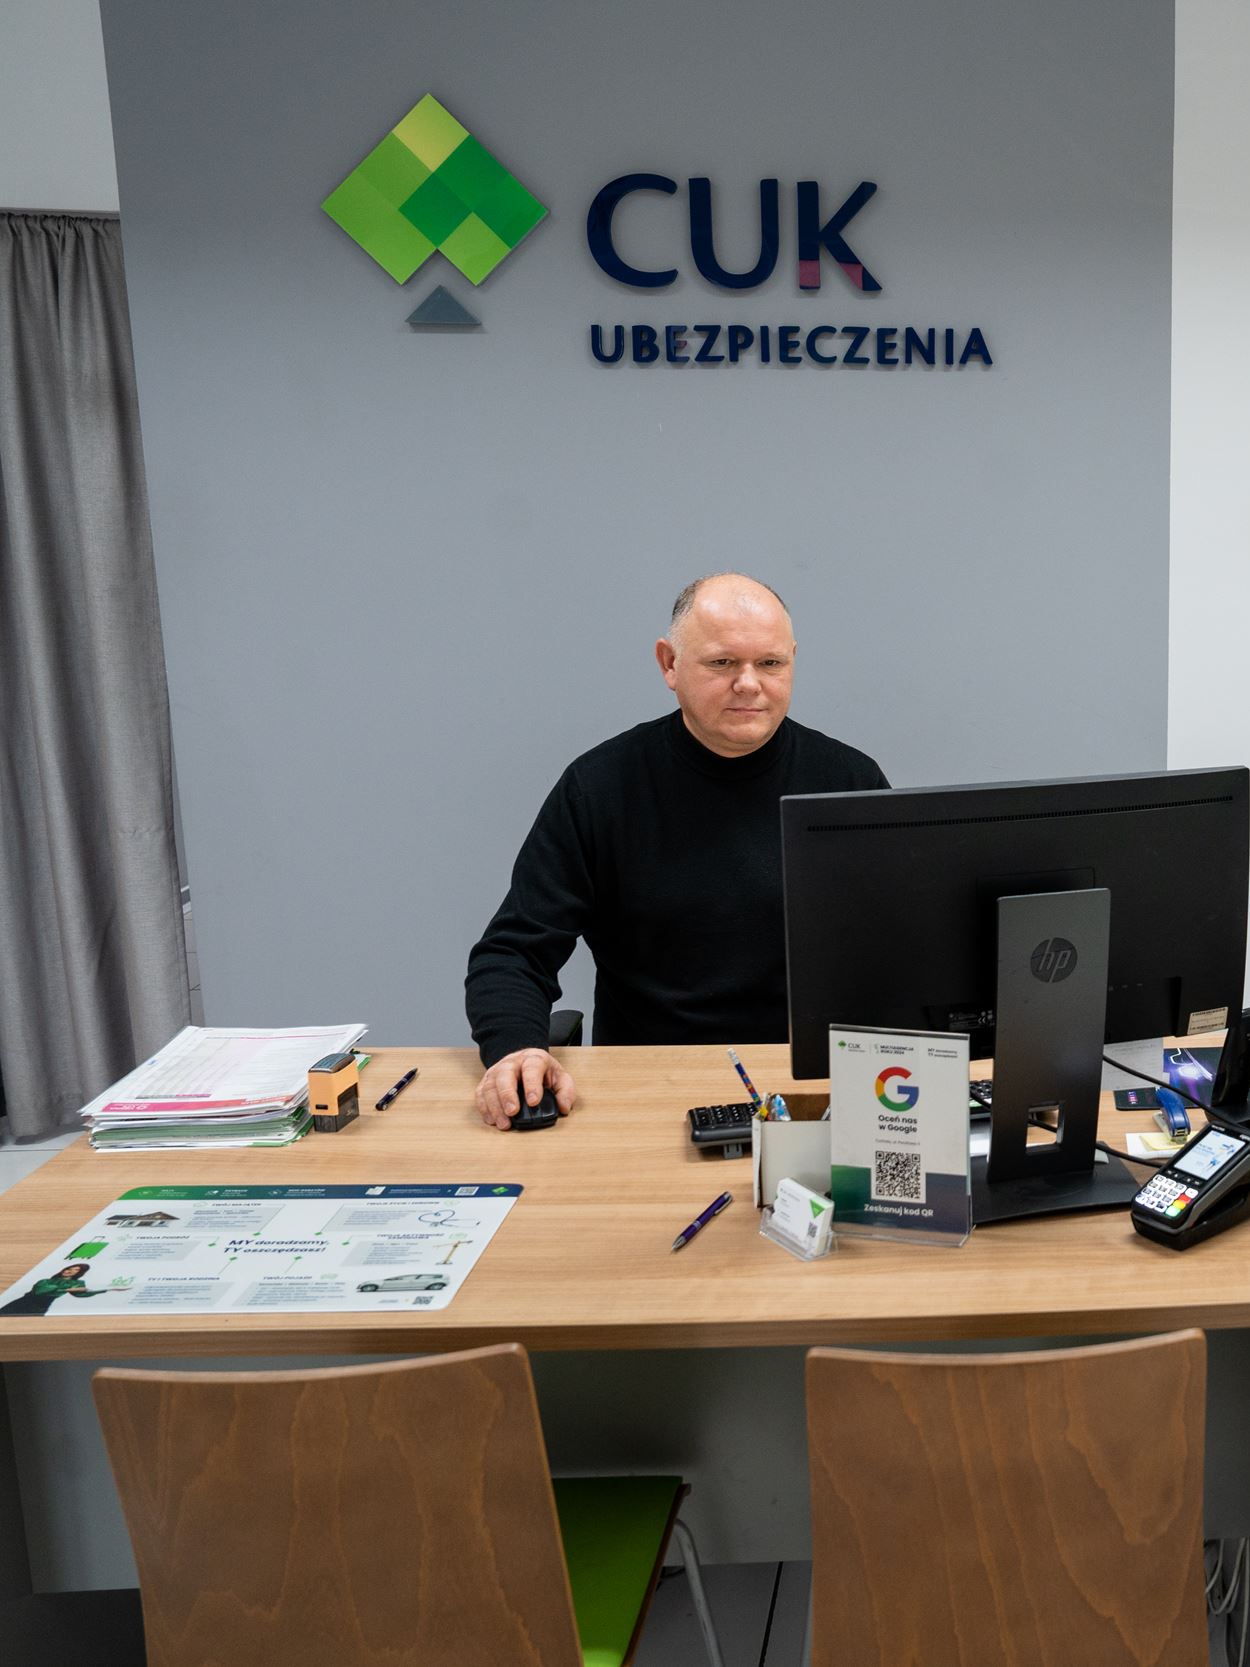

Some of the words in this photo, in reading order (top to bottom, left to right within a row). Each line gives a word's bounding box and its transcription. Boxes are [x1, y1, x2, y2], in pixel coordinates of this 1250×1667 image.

[587, 173, 882, 291] CUK
[591, 324, 992, 365] UBEZPIECZENIA
[1036, 938, 1073, 983] hp
[878, 1114, 900, 1122] Oceń
[887, 1124, 917, 1134] Google
[864, 1203, 902, 1217] Zeskanuj
[904, 1207, 920, 1216] kod
[921, 1209, 934, 1217] QR
